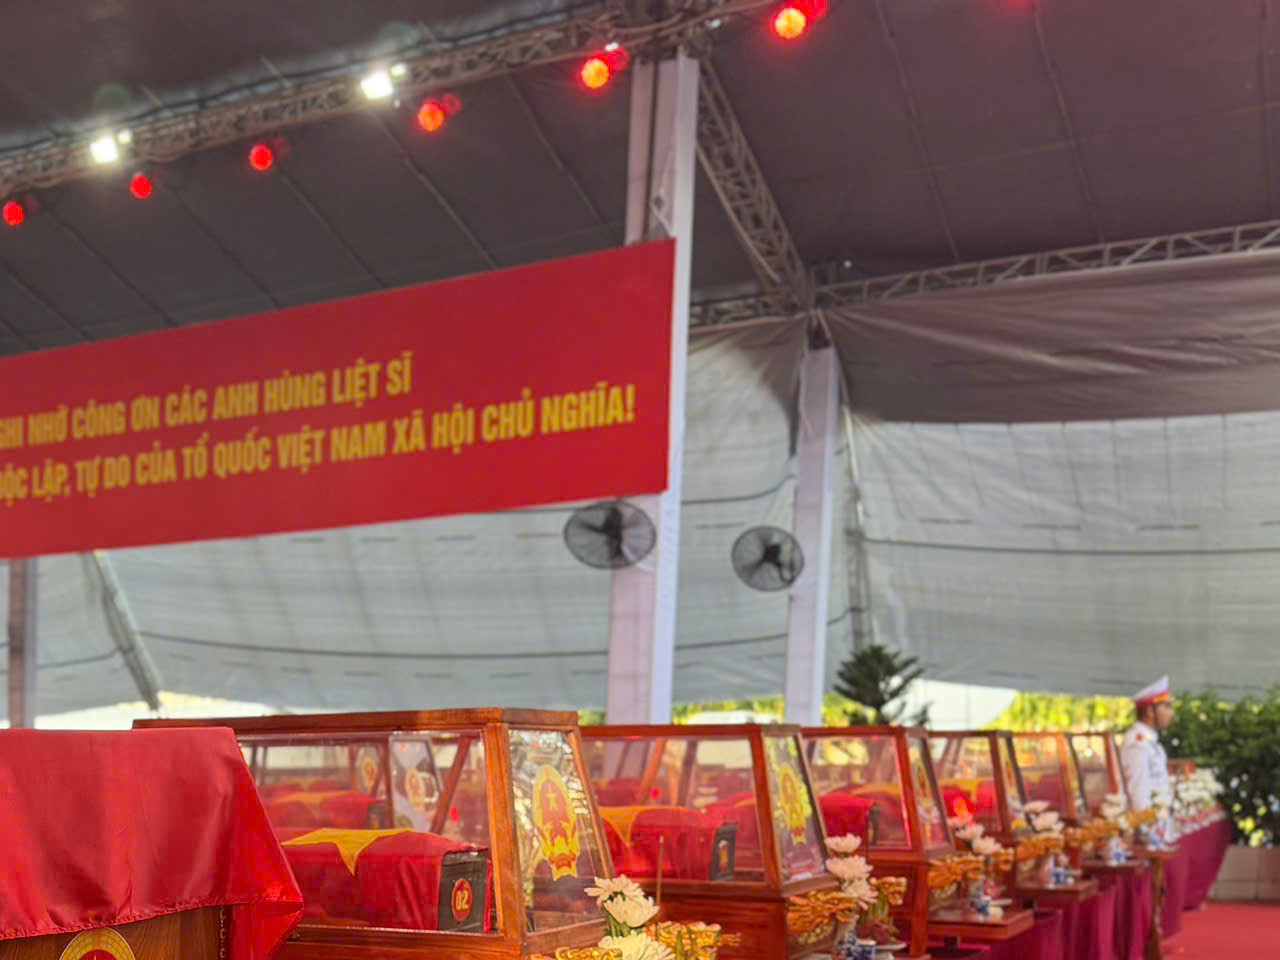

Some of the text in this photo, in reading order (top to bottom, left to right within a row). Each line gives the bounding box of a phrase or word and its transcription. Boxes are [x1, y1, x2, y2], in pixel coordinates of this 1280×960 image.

[28, 404, 68, 446] NHỚ
[72, 399, 126, 439] CÔNG
[131, 394, 160, 432] ƠN
[165, 384, 208, 427] CÁC
[213, 382, 258, 420] ANH
[263, 369, 326, 413] HÙNG
[332, 358, 381, 408] LIỆT
[385, 351, 413, 396] SĨ
[75, 456, 102, 498] TỰ
[104, 456, 131, 489] DO
[136, 440, 177, 486] CỦA
[182, 431, 210, 480] TỔ
[213, 426, 271, 479] QUỐC
[277, 425, 326, 474] VIỆT
[331, 420, 386, 462] NAM
[393, 408, 426, 454] XÃ
[432, 402, 475, 455] HỘI
[481, 387, 535, 443] CHỦ
[541, 381, 635, 434] NGHĨA!
[455, 889, 469, 911] 02
